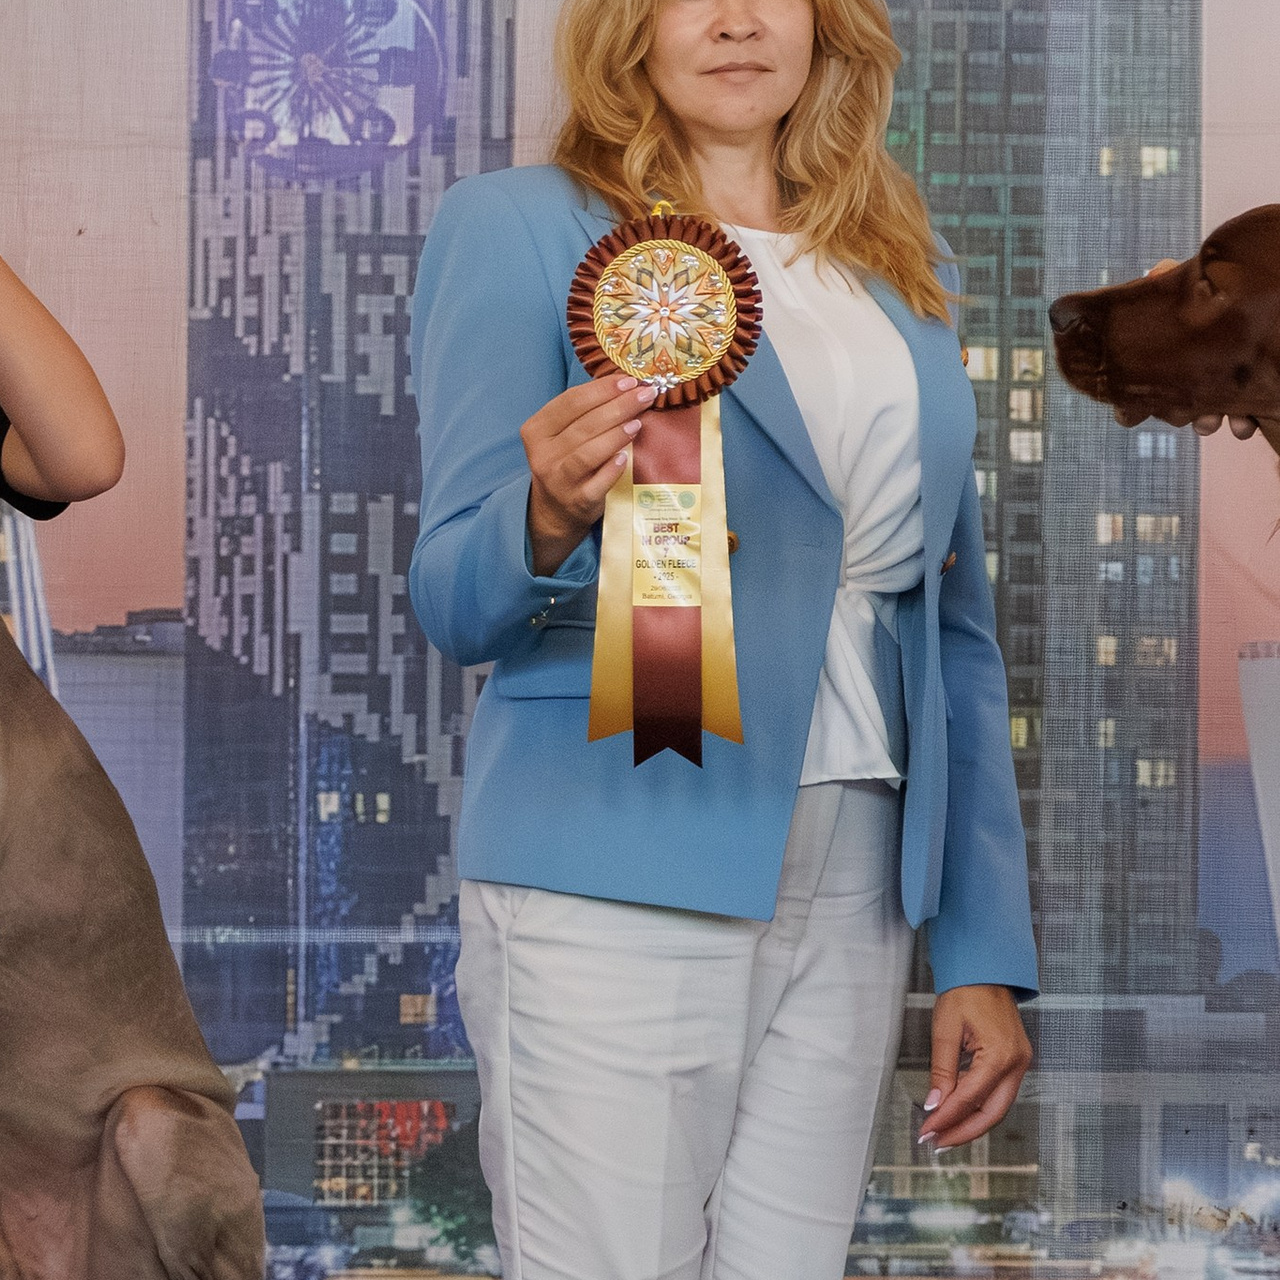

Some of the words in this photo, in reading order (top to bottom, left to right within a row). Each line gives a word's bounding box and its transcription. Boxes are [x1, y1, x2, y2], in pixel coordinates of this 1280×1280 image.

[653, 522, 680, 533] BEST
[654, 535, 691, 546] GROUP
[668, 559, 697, 569] FLEECE
